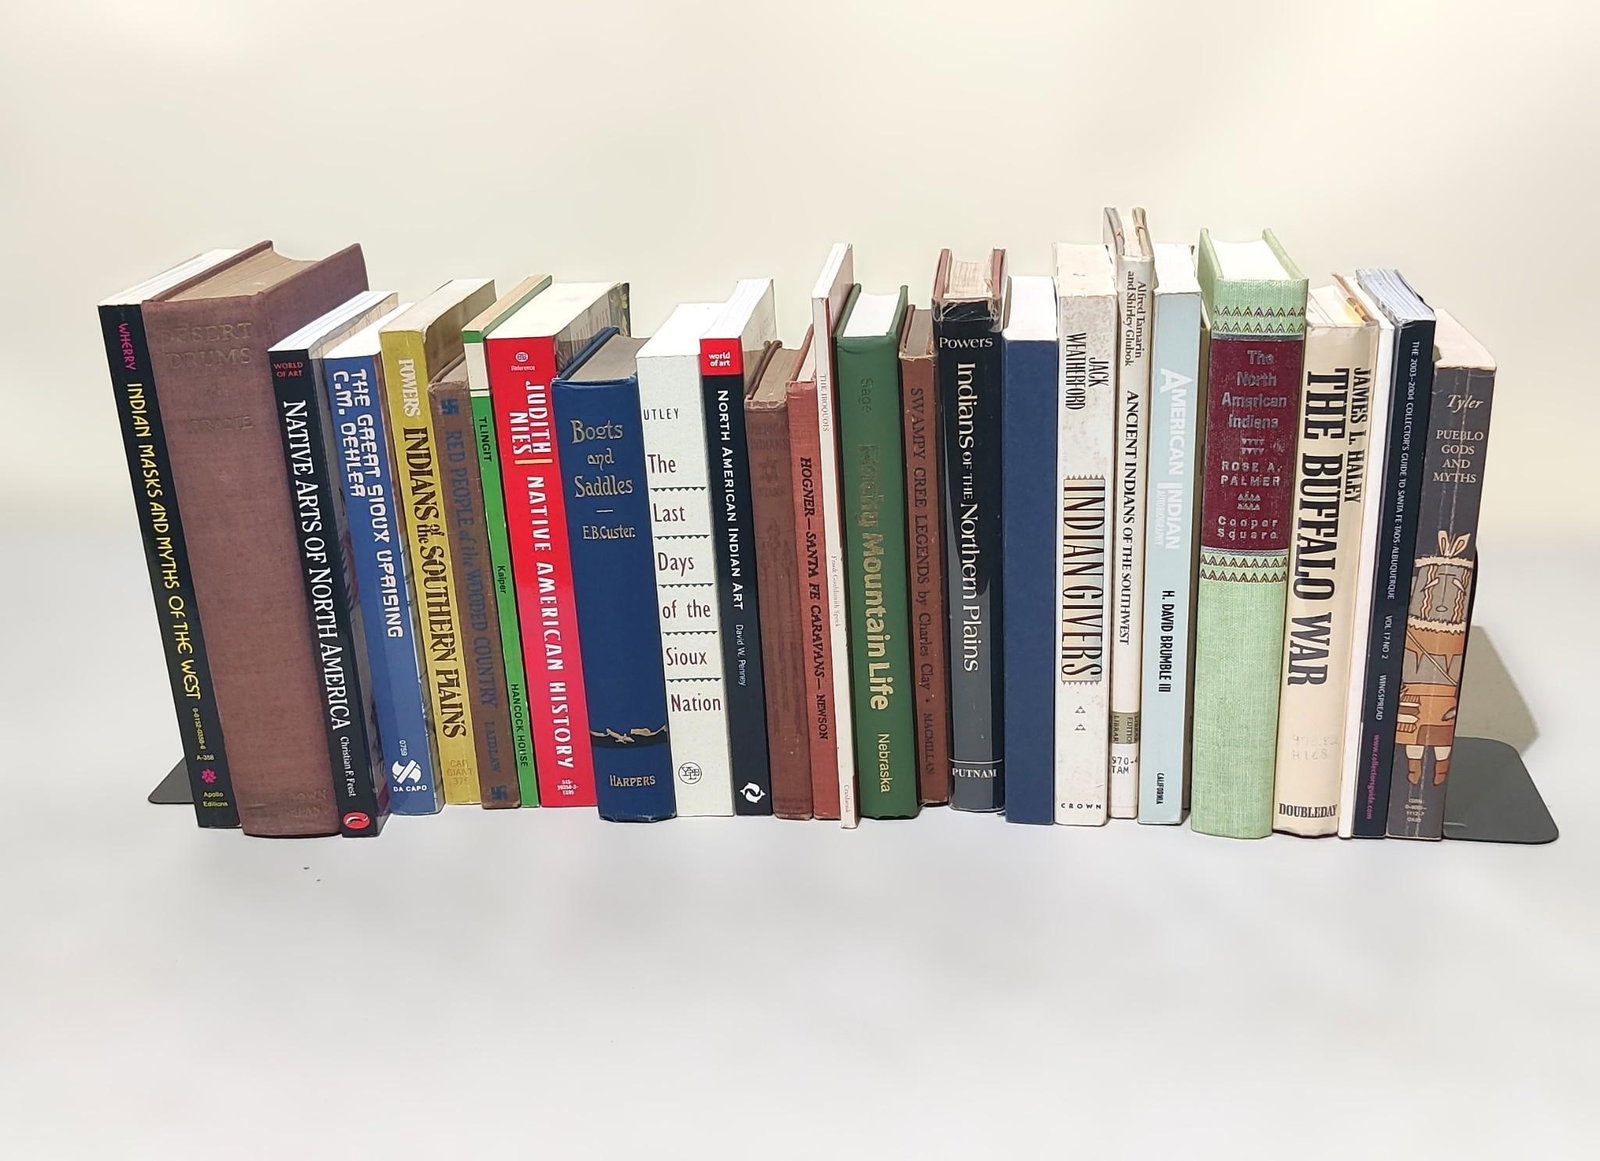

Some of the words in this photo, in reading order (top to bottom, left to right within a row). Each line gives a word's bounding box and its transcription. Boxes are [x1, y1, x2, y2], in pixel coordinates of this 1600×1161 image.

[1127, 270, 1135, 290] and
[1122, 292, 1136, 328] Shirley
[1137, 280, 1147, 318] Alfred
[118, 323, 137, 371] WHERRY
[160, 322, 252, 344] DESERT
[939, 336, 993, 348] Powers
[1124, 329, 1135, 366] Glubok
[1135, 318, 1146, 358] Tamarin
[1412, 341, 1420, 356] THE
[165, 348, 252, 368] DRUMS
[274, 362, 304, 370] WORLD
[287, 370, 303, 378] ART
[708, 352, 731, 360] world
[710, 359, 719, 367] of
[1065, 332, 1087, 410] WEATHERFORD
[1088, 356, 1110, 388] JACK
[1247, 350, 1274, 365] The
[332, 370, 353, 416] C.M.
[350, 369, 370, 407] THE
[398, 358, 420, 418] POWERS
[858, 378, 874, 413] Sage
[1236, 371, 1277, 386] North
[1350, 367, 1372, 424] JAMES
[127, 383, 152, 438] INDIAN
[525, 380, 552, 454] JUDITH
[643, 408, 680, 420] UTLEY
[718, 390, 731, 441] NORTH
[821, 394, 830, 432] IROQUOIS
[958, 362, 978, 450] Indians
[1222, 392, 1288, 408] American
[1304, 368, 1350, 440] THE
[1447, 394, 1484, 414] Tyler
[283, 400, 314, 476] NATIVE
[478, 416, 492, 462] TLINGIT
[509, 412, 532, 455] NIES
[570, 420, 624, 444] Boots
[911, 387, 926, 460] SWAMPY
[1125, 390, 1139, 460] ANCIENT
[1159, 368, 1194, 476] AMERICAN
[1228, 414, 1280, 430] Indians
[1348, 432, 1367, 446] L.
[1402, 402, 1414, 452] COLLECTOR'S
[1436, 430, 1484, 442] PUEBLO
[341, 422, 366, 498] OEHLER
[357, 414, 381, 478] GREAT
[446, 431, 466, 464] RED
[586, 448, 616, 470] and
[648, 454, 676, 474] The
[962, 451, 972, 470] OF
[1441, 444, 1475, 455] GODS
[1442, 458, 1471, 469] AND
[138, 444, 163, 498] MASKS
[403, 426, 440, 521] INDIANS
[1220, 474, 1280, 487] PALMER
[1221, 460, 1260, 472] ROSE
[1344, 450, 1365, 503] HALEY
[1400, 452, 1409, 477] GUIDE
[1432, 472, 1477, 483] MYTHS
[451, 468, 475, 527] PEOPLE
[574, 476, 634, 498] Saddles
[722, 446, 738, 522] AMERICAN
[913, 467, 928, 508] CREE
[962, 472, 973, 500] THE
[1123, 462, 1136, 524] INDIANS
[1396, 490, 1406, 513] SANTA
[1398, 479, 1406, 488] TO
[150, 502, 169, 533] AND
[296, 480, 322, 533] ARTS
[367, 484, 390, 543] SIOUX
[527, 476, 552, 552] NATIVE
[653, 502, 686, 522] Last
[1156, 482, 1184, 550] INDIAN
[1218, 516, 1278, 532] Cooper
[416, 524, 430, 544] the
[430, 524, 445, 538] of
[1063, 486, 1105, 576] INDIAN
[1122, 526, 1134, 544] OF
[1216, 528, 1278, 541] Square
[1293, 453, 1344, 600] BUFFALO
[156, 537, 180, 589] MYTHS
[304, 538, 328, 564] OF
[658, 552, 694, 577] Days
[728, 528, 741, 578] INDIAN
[915, 514, 930, 584] LEGENDS
[960, 503, 981, 600] Northern
[1121, 546, 1132, 570] THE
[376, 550, 404, 638] UPRISING
[496, 565, 506, 594] Kaiper
[732, 582, 744, 610] ART
[808, 582, 820, 600] FE
[862, 532, 891, 658] Mountain
[1162, 590, 1176, 600] H.
[168, 596, 186, 619] OF
[309, 568, 338, 639] NORTH
[420, 546, 458, 662] SOUTHERN
[466, 570, 488, 632] WOODED
[662, 600, 676, 618] of
[687, 600, 711, 618] the
[916, 591, 930, 606] by
[1120, 572, 1132, 645] SOUTHWEST
[536, 562, 564, 672] AMERICAN
[736, 624, 744, 646] David
[918, 612, 933, 657] Charles
[1062, 585, 1104, 676] GIVERS
[1160, 603, 1175, 632] DAVID
[1384, 616, 1392, 629] VOL
[173, 622, 193, 654] THE
[962, 604, 982, 672] Plains
[1288, 612, 1332, 686] WAR
[474, 636, 498, 709] COUNTRY
[666, 647, 708, 666] Sioux
[738, 659, 747, 686] Penney
[1159, 634, 1174, 680] BRUMBLE
[180, 659, 200, 700] WEST
[320, 643, 350, 730] AMERICA
[868, 662, 894, 710] Life
[919, 664, 934, 690] Clay
[1158, 682, 1171, 693] III
[436, 669, 466, 738] PLAINS
[670, 693, 722, 712] Nation
[1376, 674, 1387, 721] WINGSPREAD
[511, 684, 524, 732] HANCOCK
[518, 735, 528, 766] HOUSE
[550, 682, 574, 769] HISTORY
[816, 694, 828, 740] NEWSON
[924, 713, 935, 776] MACMILLAN
[340, 736, 352, 770] Christian
[346, 778, 357, 798] Feest
[609, 774, 656, 787] HARPERS
[878, 734, 893, 793] Nebraska
[952, 768, 997, 779] PUTNAM
[1112, 766, 1129, 774] TAM
[1156, 772, 1165, 805] CALIFORNIA
[1278, 802, 1338, 819] DOUBLEDAY
